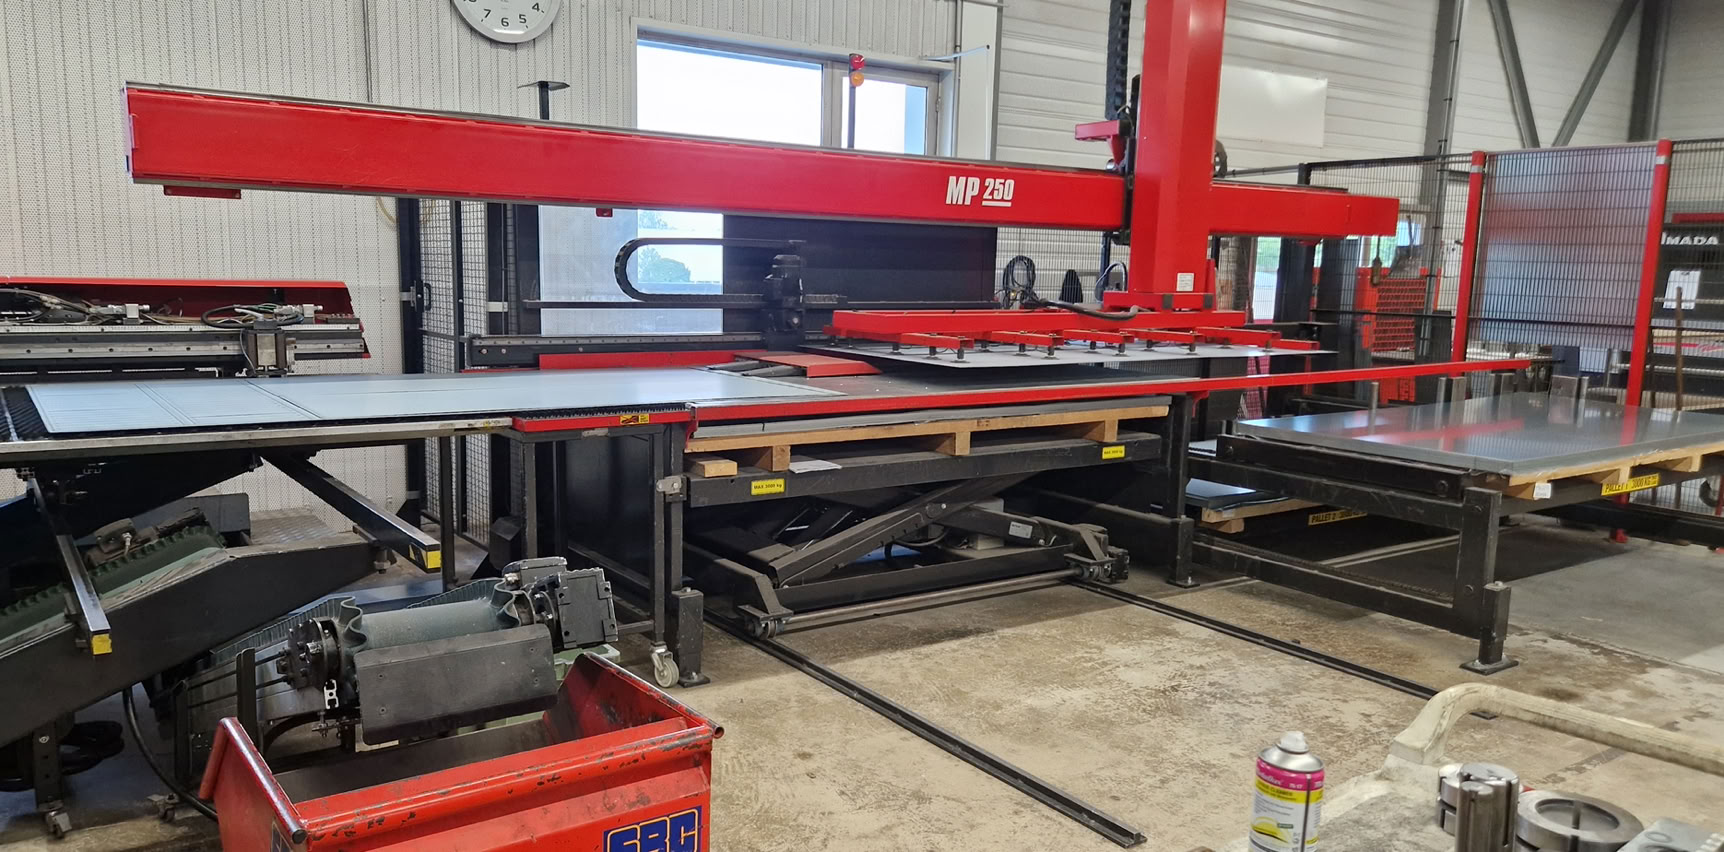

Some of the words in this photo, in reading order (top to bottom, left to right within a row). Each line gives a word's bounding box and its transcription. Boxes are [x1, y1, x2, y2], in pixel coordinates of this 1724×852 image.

[532, 2, 540, 12] 4
[483, 8, 492, 19] 7
[500, 17, 510, 27] 6
[518, 14, 527, 24] 5
[945, 175, 981, 206] MP
[982, 177, 1015, 201] 250
